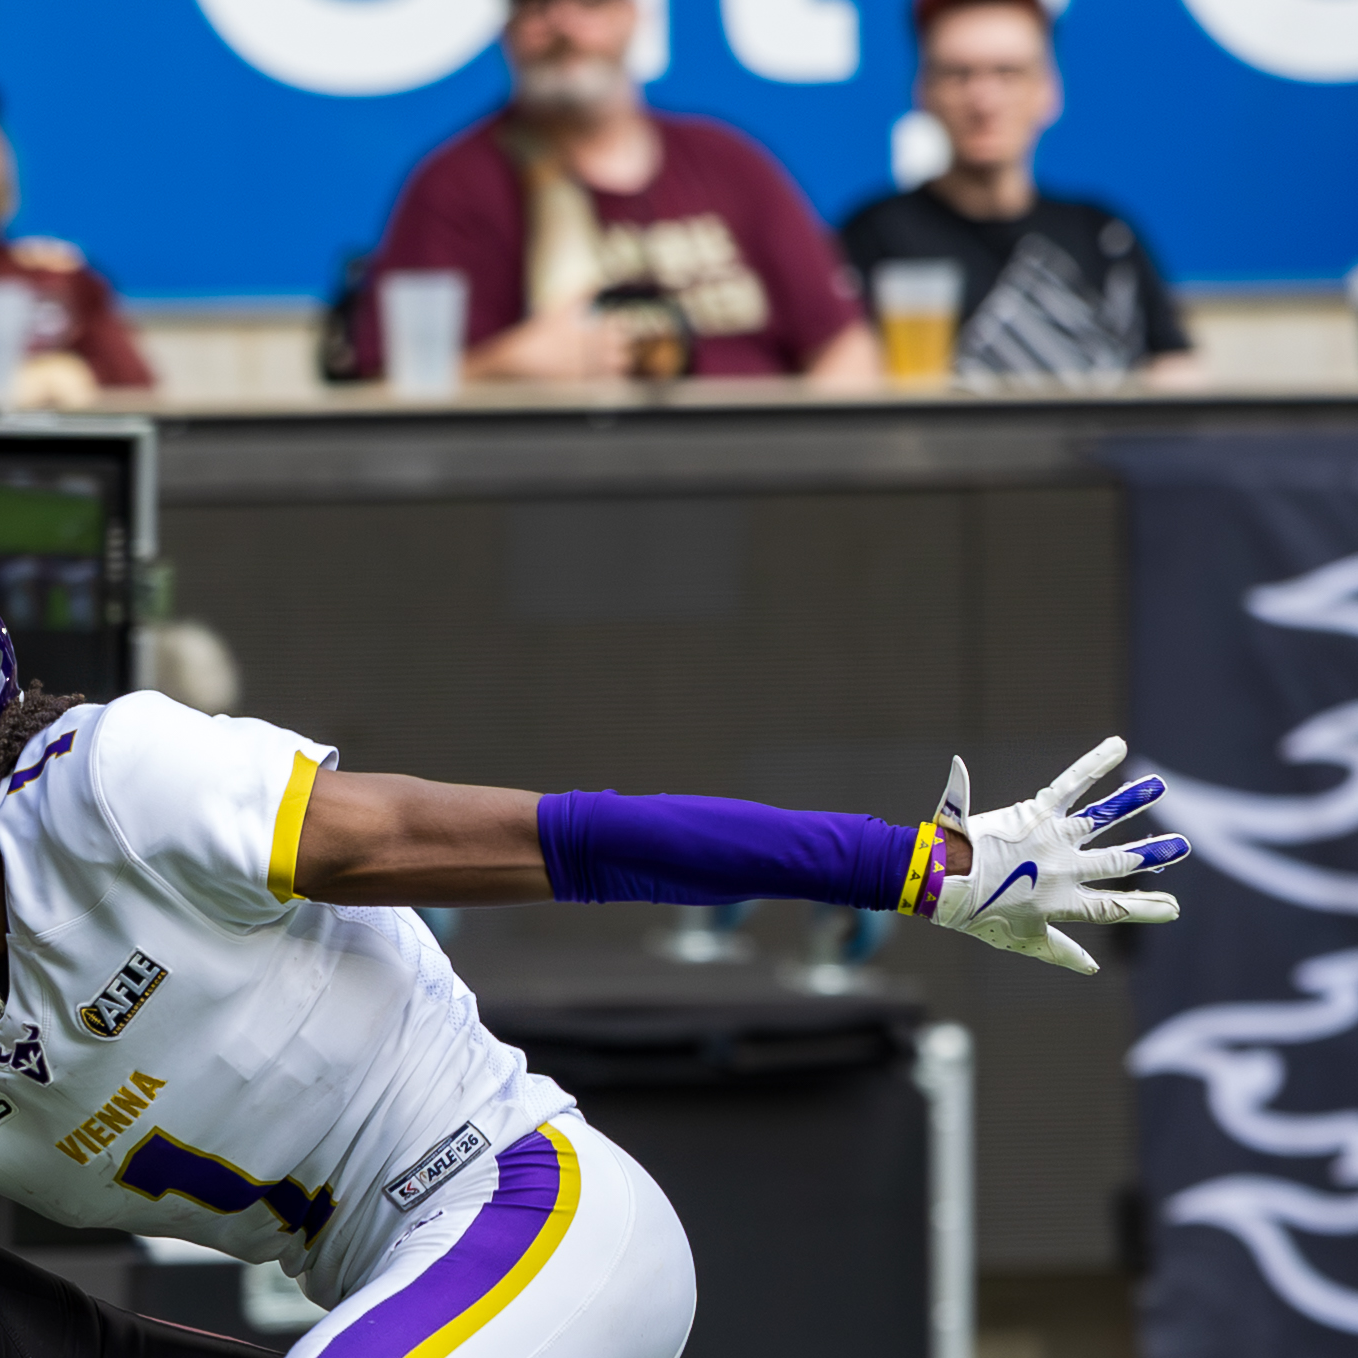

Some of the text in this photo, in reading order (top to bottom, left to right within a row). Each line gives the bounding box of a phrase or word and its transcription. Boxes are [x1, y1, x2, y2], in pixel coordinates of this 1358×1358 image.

[6, 729, 78, 796] 1
[94, 953, 161, 1031] AFLE
[55, 1070, 168, 1165] VIENNA
[113, 1125, 340, 1252] 1
[427, 1149, 458, 1182] AFLE
[455, 1134, 479, 1154] '26
